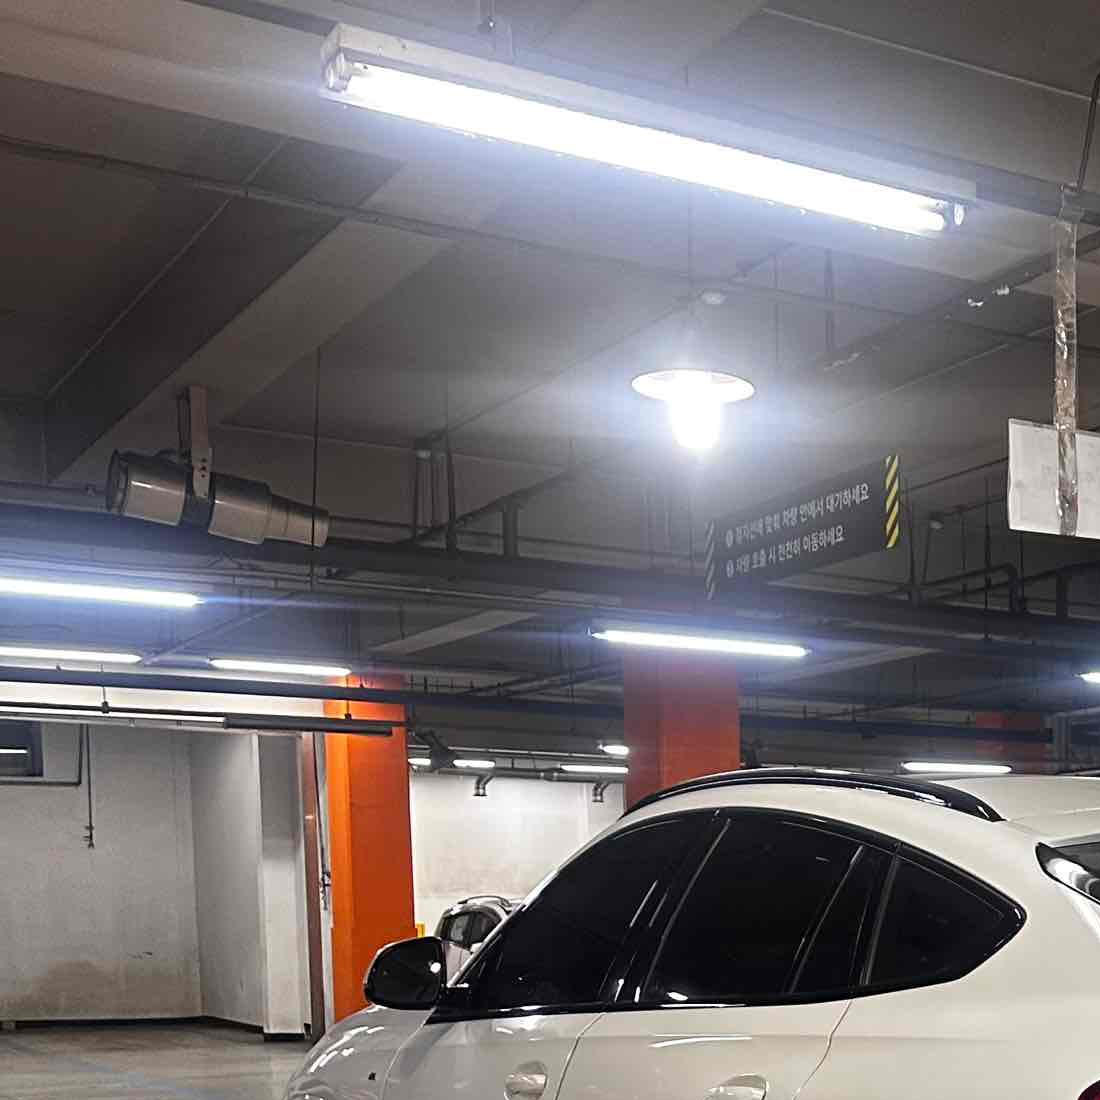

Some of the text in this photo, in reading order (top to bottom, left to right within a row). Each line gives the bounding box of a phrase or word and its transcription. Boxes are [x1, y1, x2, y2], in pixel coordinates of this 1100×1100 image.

[800, 496, 824, 523] 안에서
[826, 483, 869, 512] 대기하세요
[802, 525, 844, 553] 이동하세요
